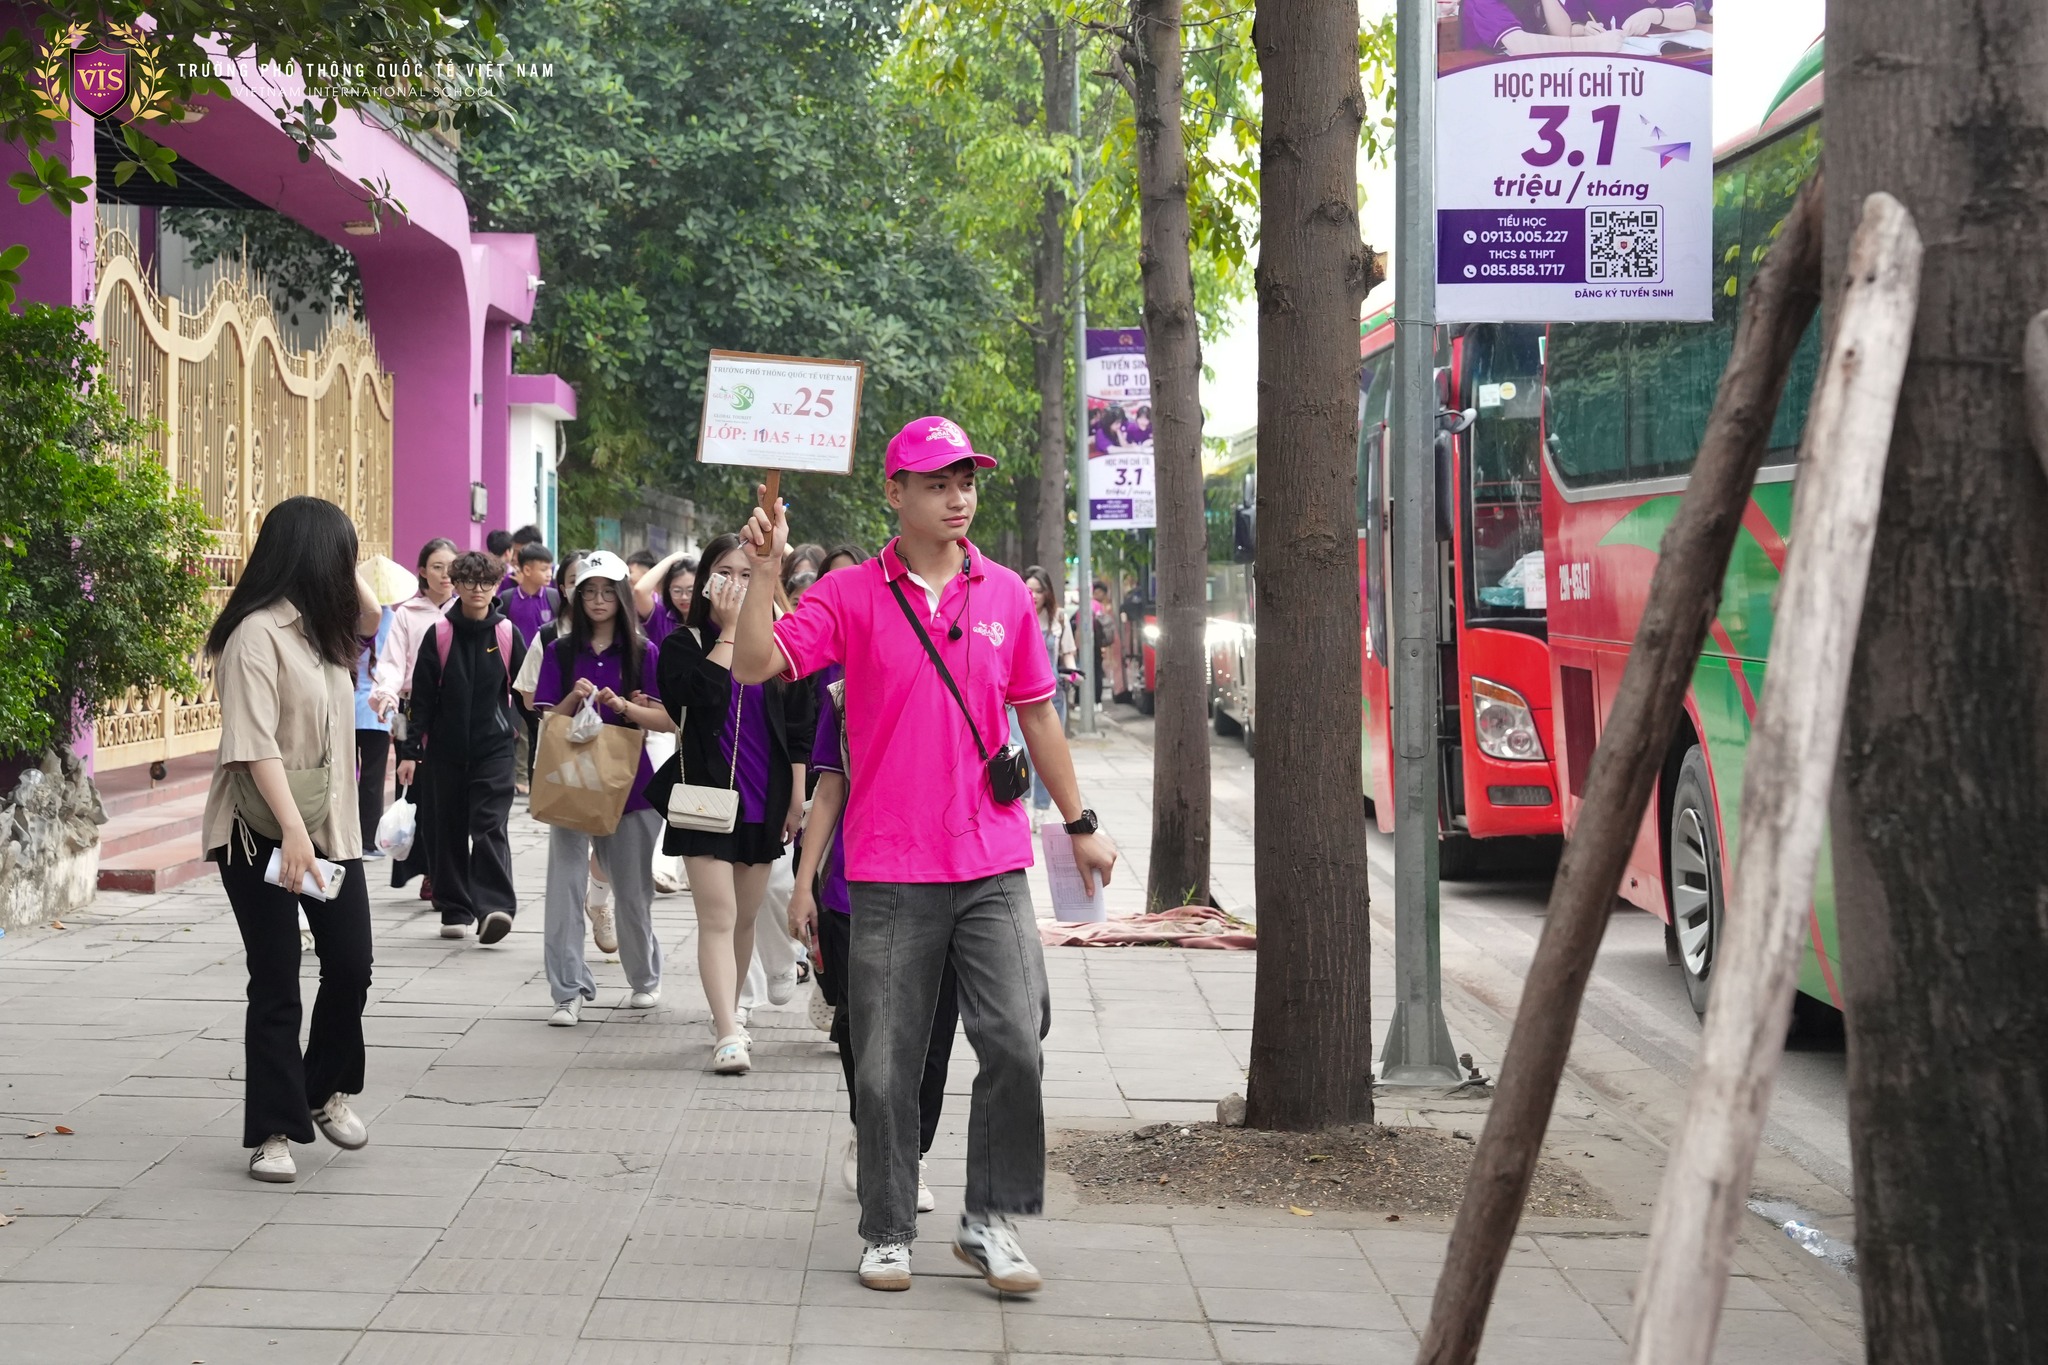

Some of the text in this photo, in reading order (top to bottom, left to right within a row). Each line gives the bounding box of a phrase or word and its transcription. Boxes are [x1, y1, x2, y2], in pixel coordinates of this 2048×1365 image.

[1494, 64, 1645, 102] HỌC PHÍ CHỈ TỪ
[1521, 105, 1620, 167] 3.1
[1494, 173, 1562, 204] triệu
[1587, 180, 1649, 200] tháng
[1497, 214, 1547, 229] TIỂU HỌC
[1480, 231, 1568, 243] 0913.005.227
[1489, 250, 1556, 259] THCS & THPT
[1480, 264, 1565, 276] 085.858.1717
[1574, 287, 1674, 298] ĐĂNG KÝ TUYỂN SINH
[1135, 374, 1147, 386] 10
[771, 387, 835, 417] XE 25
[706, 423, 747, 440] LỚP:
[810, 433, 847, 448] 12A2
[1114, 468, 1142, 486] 3.1
